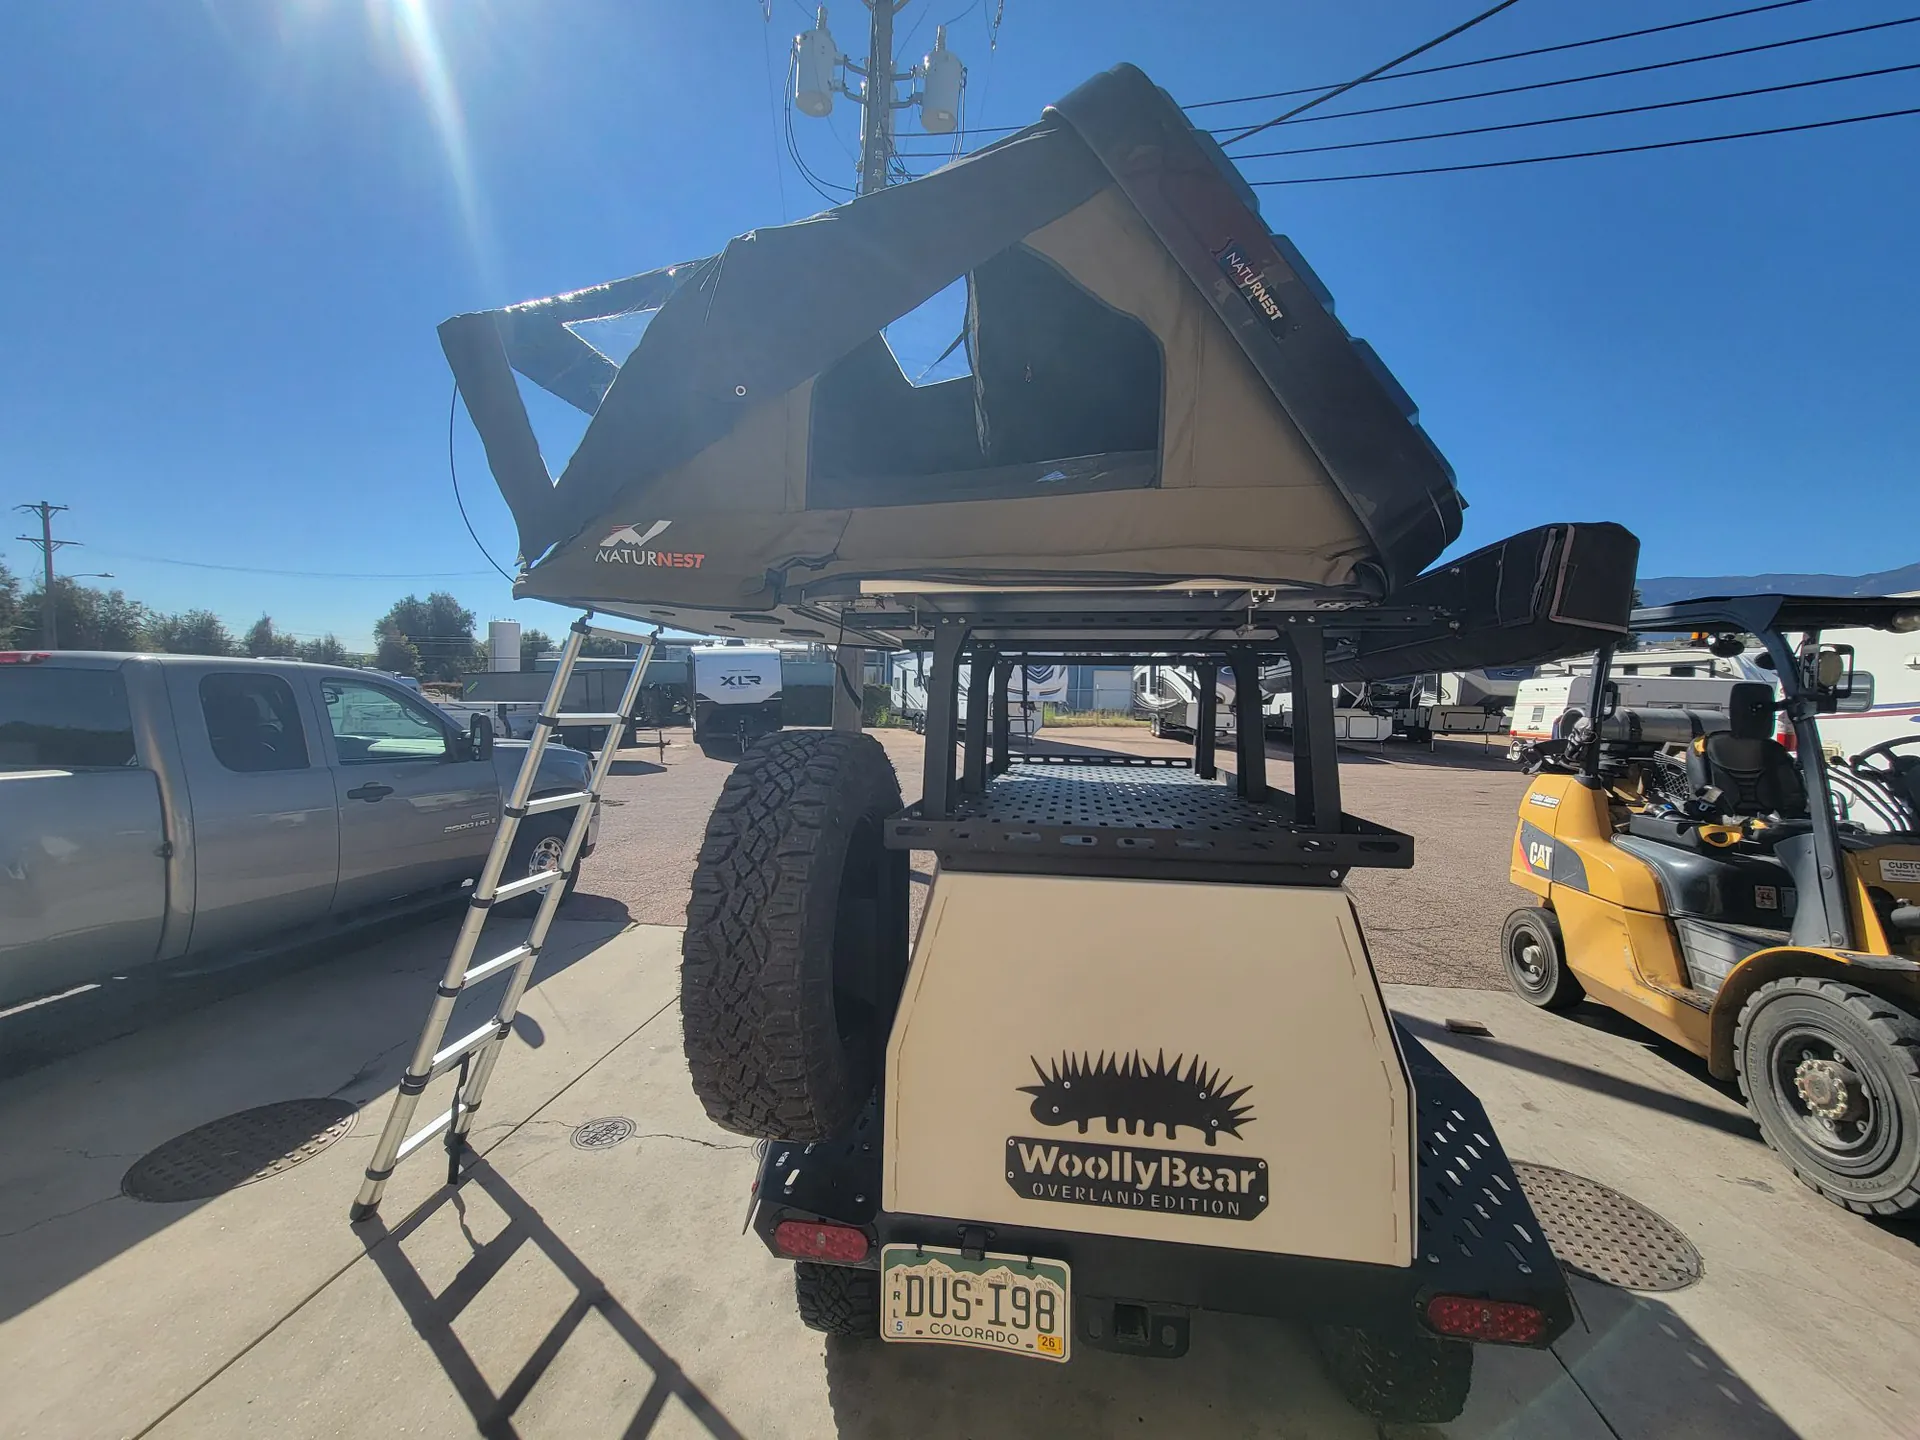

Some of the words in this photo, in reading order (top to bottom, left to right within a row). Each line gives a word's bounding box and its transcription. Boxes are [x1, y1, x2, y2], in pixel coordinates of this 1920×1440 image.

[1226, 252, 1283, 321] NATURNEST
[595, 549, 705, 569] NATURNEST
[720, 675, 762, 687] XLR
[1529, 841, 1553, 871] CAT
[1017, 1142, 1257, 1194] WoollyBear
[1032, 1182, 1145, 1206] OVERLAND
[1150, 1196, 1240, 1216] EDITION
[895, 1321, 904, 1332] 5
[929, 1322, 1019, 1345] COLORADO
[1041, 1335, 1056, 1348] 26
